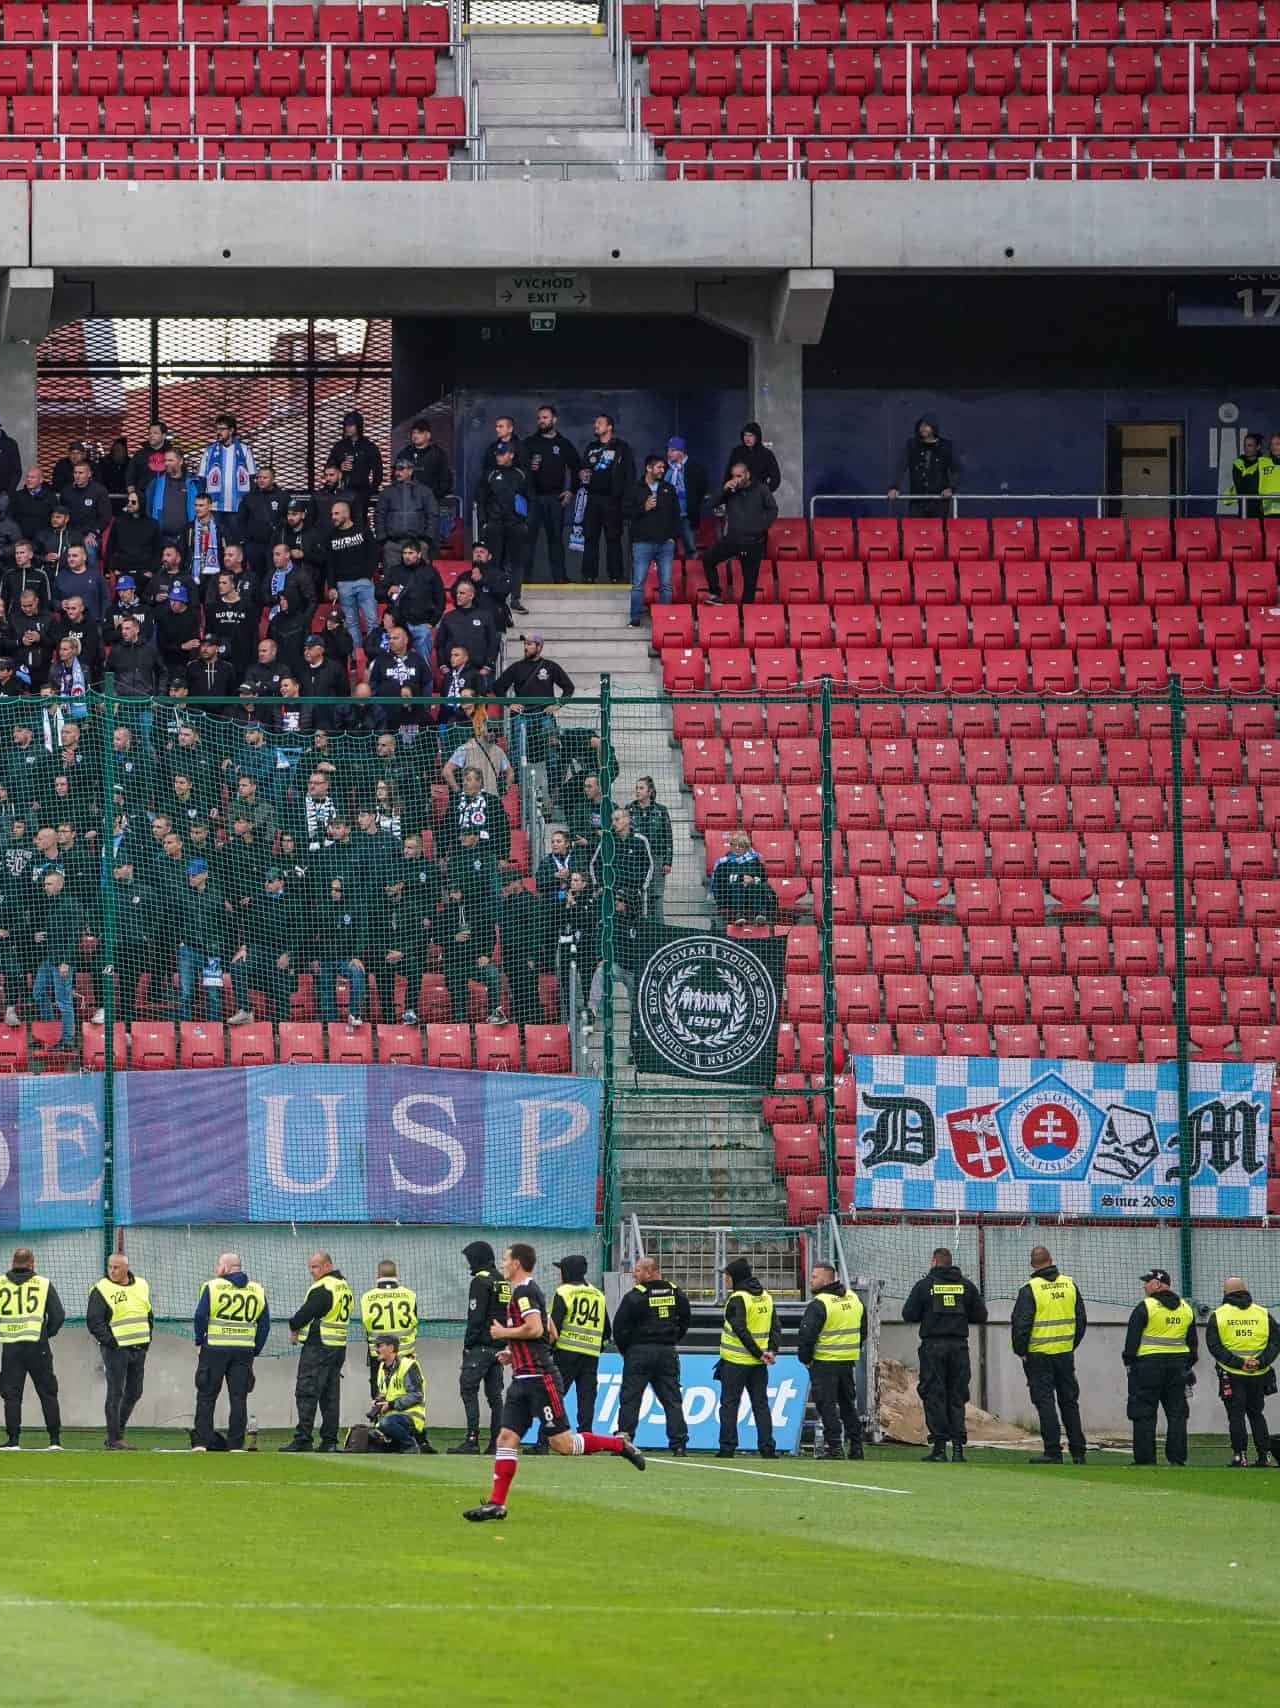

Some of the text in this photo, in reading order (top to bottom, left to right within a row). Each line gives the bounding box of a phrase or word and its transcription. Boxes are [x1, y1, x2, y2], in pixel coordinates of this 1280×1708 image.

[527, 292, 560, 303] EXIT
[1237, 288, 1280, 318] 17
[650, 946, 706, 1059] YOUNG BOYS SLOVAN
[707, 951, 766, 1065] YOUNG BOYS SLOVAN
[687, 1015, 721, 1028] 1919
[861, 1091, 936, 1169] D
[258, 1094, 590, 1198] USP
[1015, 1145, 1085, 1171] BRATISLAVA
[1143, 1195, 1176, 1208] 2008
[0, 1287, 40, 1315] 215
[216, 1293, 259, 1322] 220
[369, 1300, 413, 1330] 213
[570, 1297, 601, 1328] 194
[1227, 1319, 1260, 1327] SECURITY
[543, 1406, 554, 1421] 8
